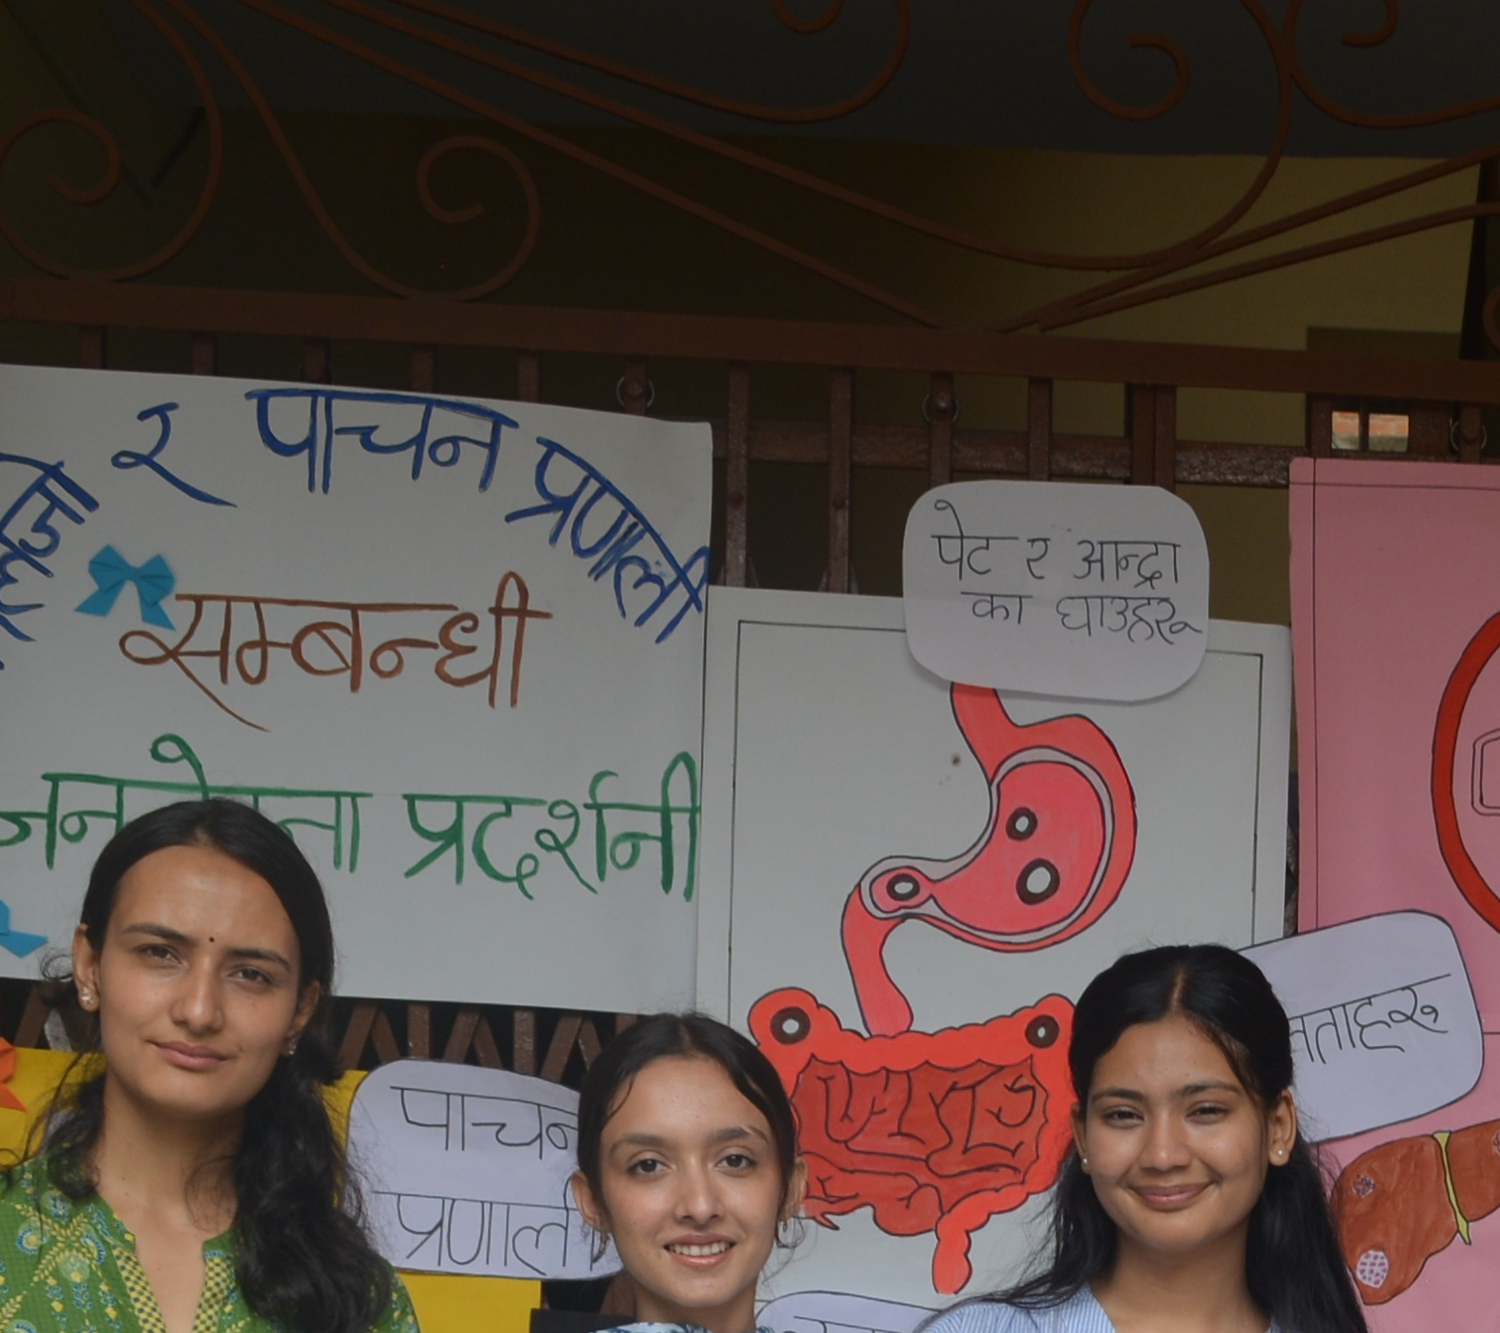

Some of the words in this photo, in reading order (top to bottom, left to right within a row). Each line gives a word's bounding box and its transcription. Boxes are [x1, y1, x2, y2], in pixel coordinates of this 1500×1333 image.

[111, 401, 239, 508] र
[245, 387, 520, 496] पाचन
[505, 436, 711, 645] प्रणाली
[930, 499, 1020, 581] पेट
[1026, 537, 1051, 580] र
[118, 570, 554, 733] सम्बन्धी
[960, 590, 1034, 626] का
[403, 749, 703, 902] प्रदर्शनी
